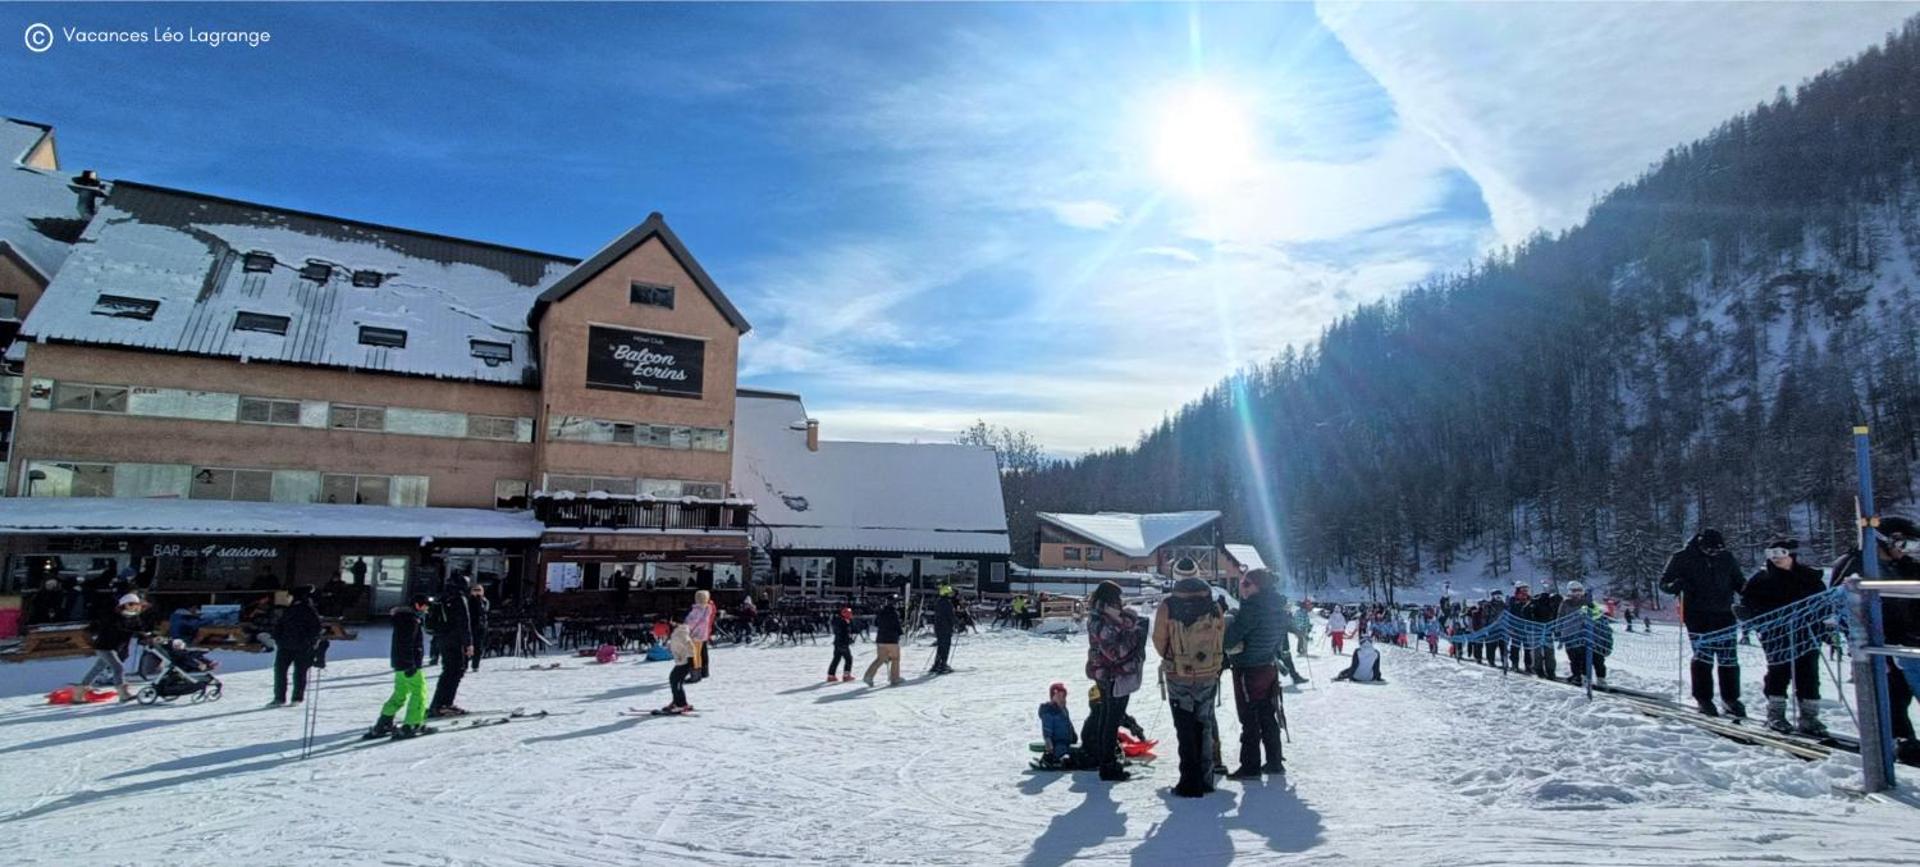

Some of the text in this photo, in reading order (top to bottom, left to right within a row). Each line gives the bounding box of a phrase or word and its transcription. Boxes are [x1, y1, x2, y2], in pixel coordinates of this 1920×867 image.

[614, 344, 676, 366] Balcon
[632, 361, 688, 381] Ecrins
[152, 543, 181, 557] BAR
[201, 543, 216, 557] 4
[216, 546, 278, 558] saisons
